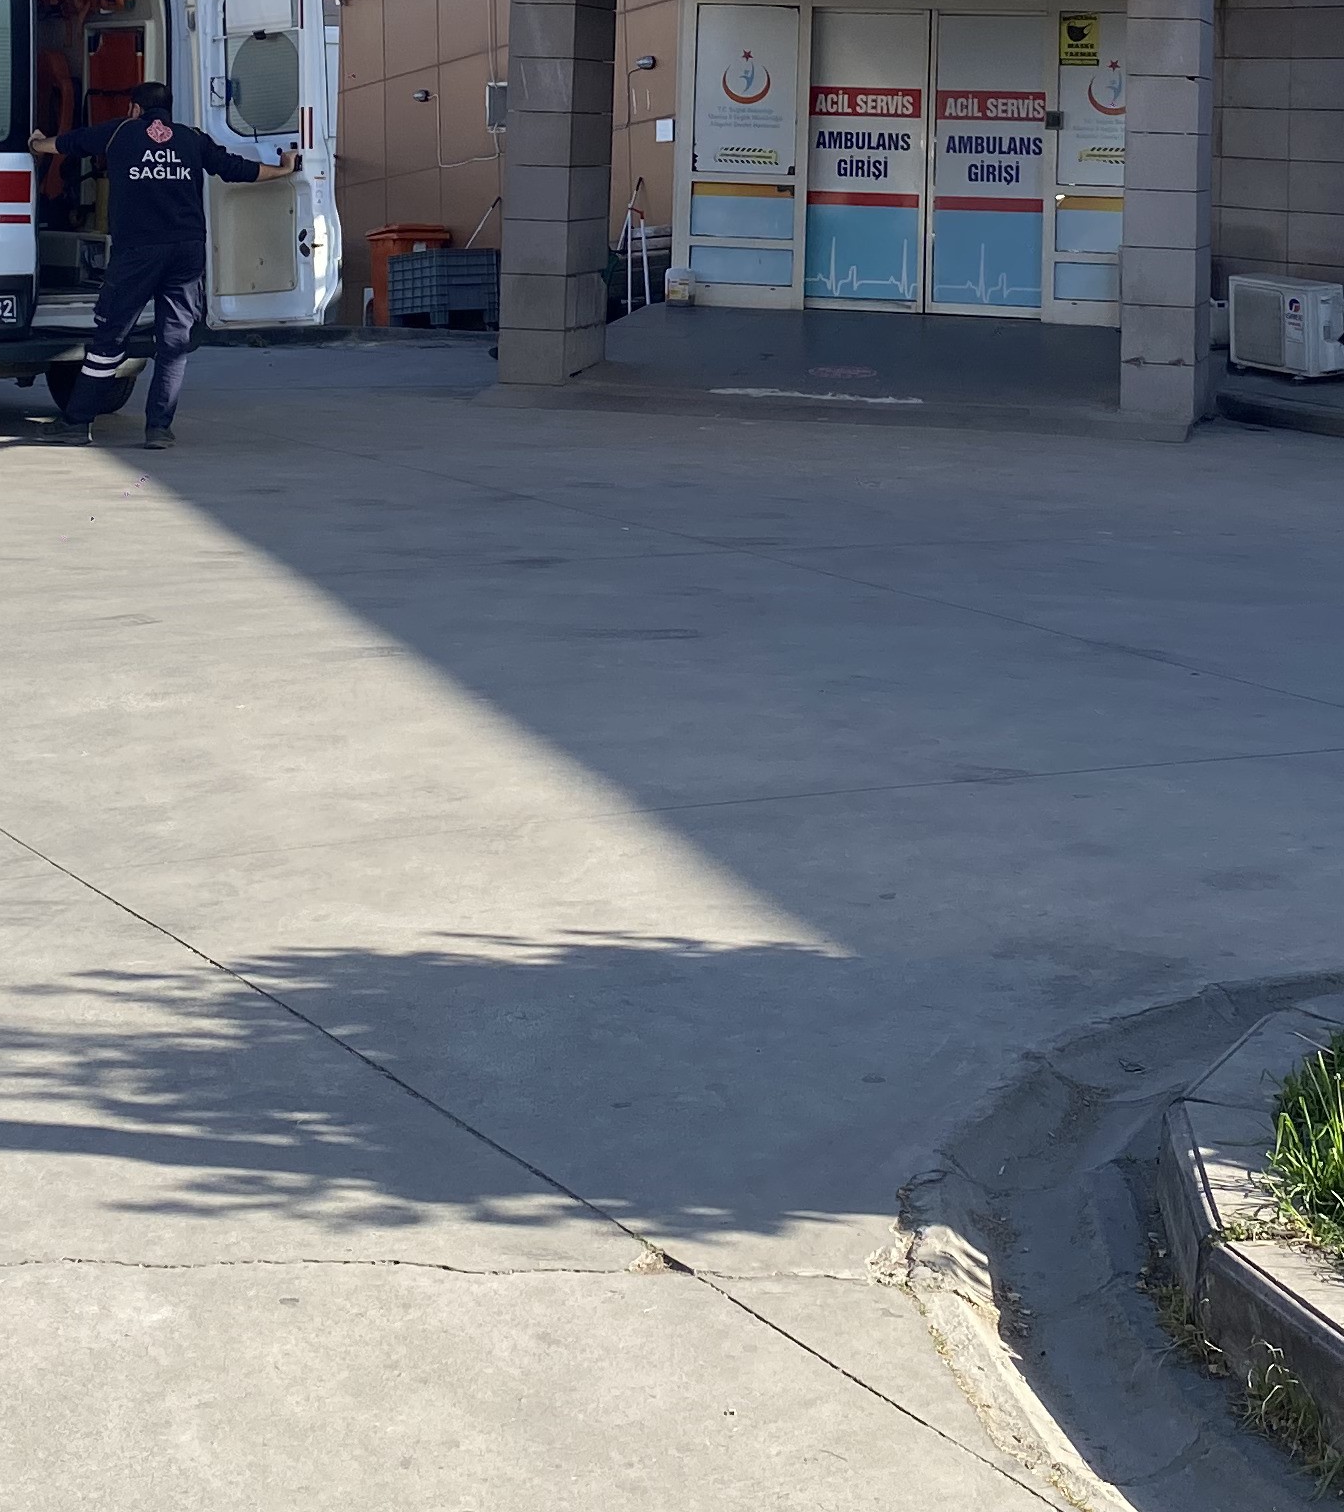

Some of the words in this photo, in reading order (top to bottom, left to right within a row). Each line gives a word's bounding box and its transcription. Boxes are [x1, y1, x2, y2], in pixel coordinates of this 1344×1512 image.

[815, 90, 853, 114] ACİL
[855, 91, 914, 115] SERVİS
[944, 94, 983, 118] ACİL
[985, 95, 1046, 120] SERVİS
[815, 131, 911, 151] AMBULANS
[945, 135, 1044, 156] AMBULANS
[141, 148, 182, 163] ACİL
[128, 163, 192, 180] SAĞLIK
[837, 155, 889, 181] GİRİŞİ
[967, 160, 1021, 186] GİRİŞİ
